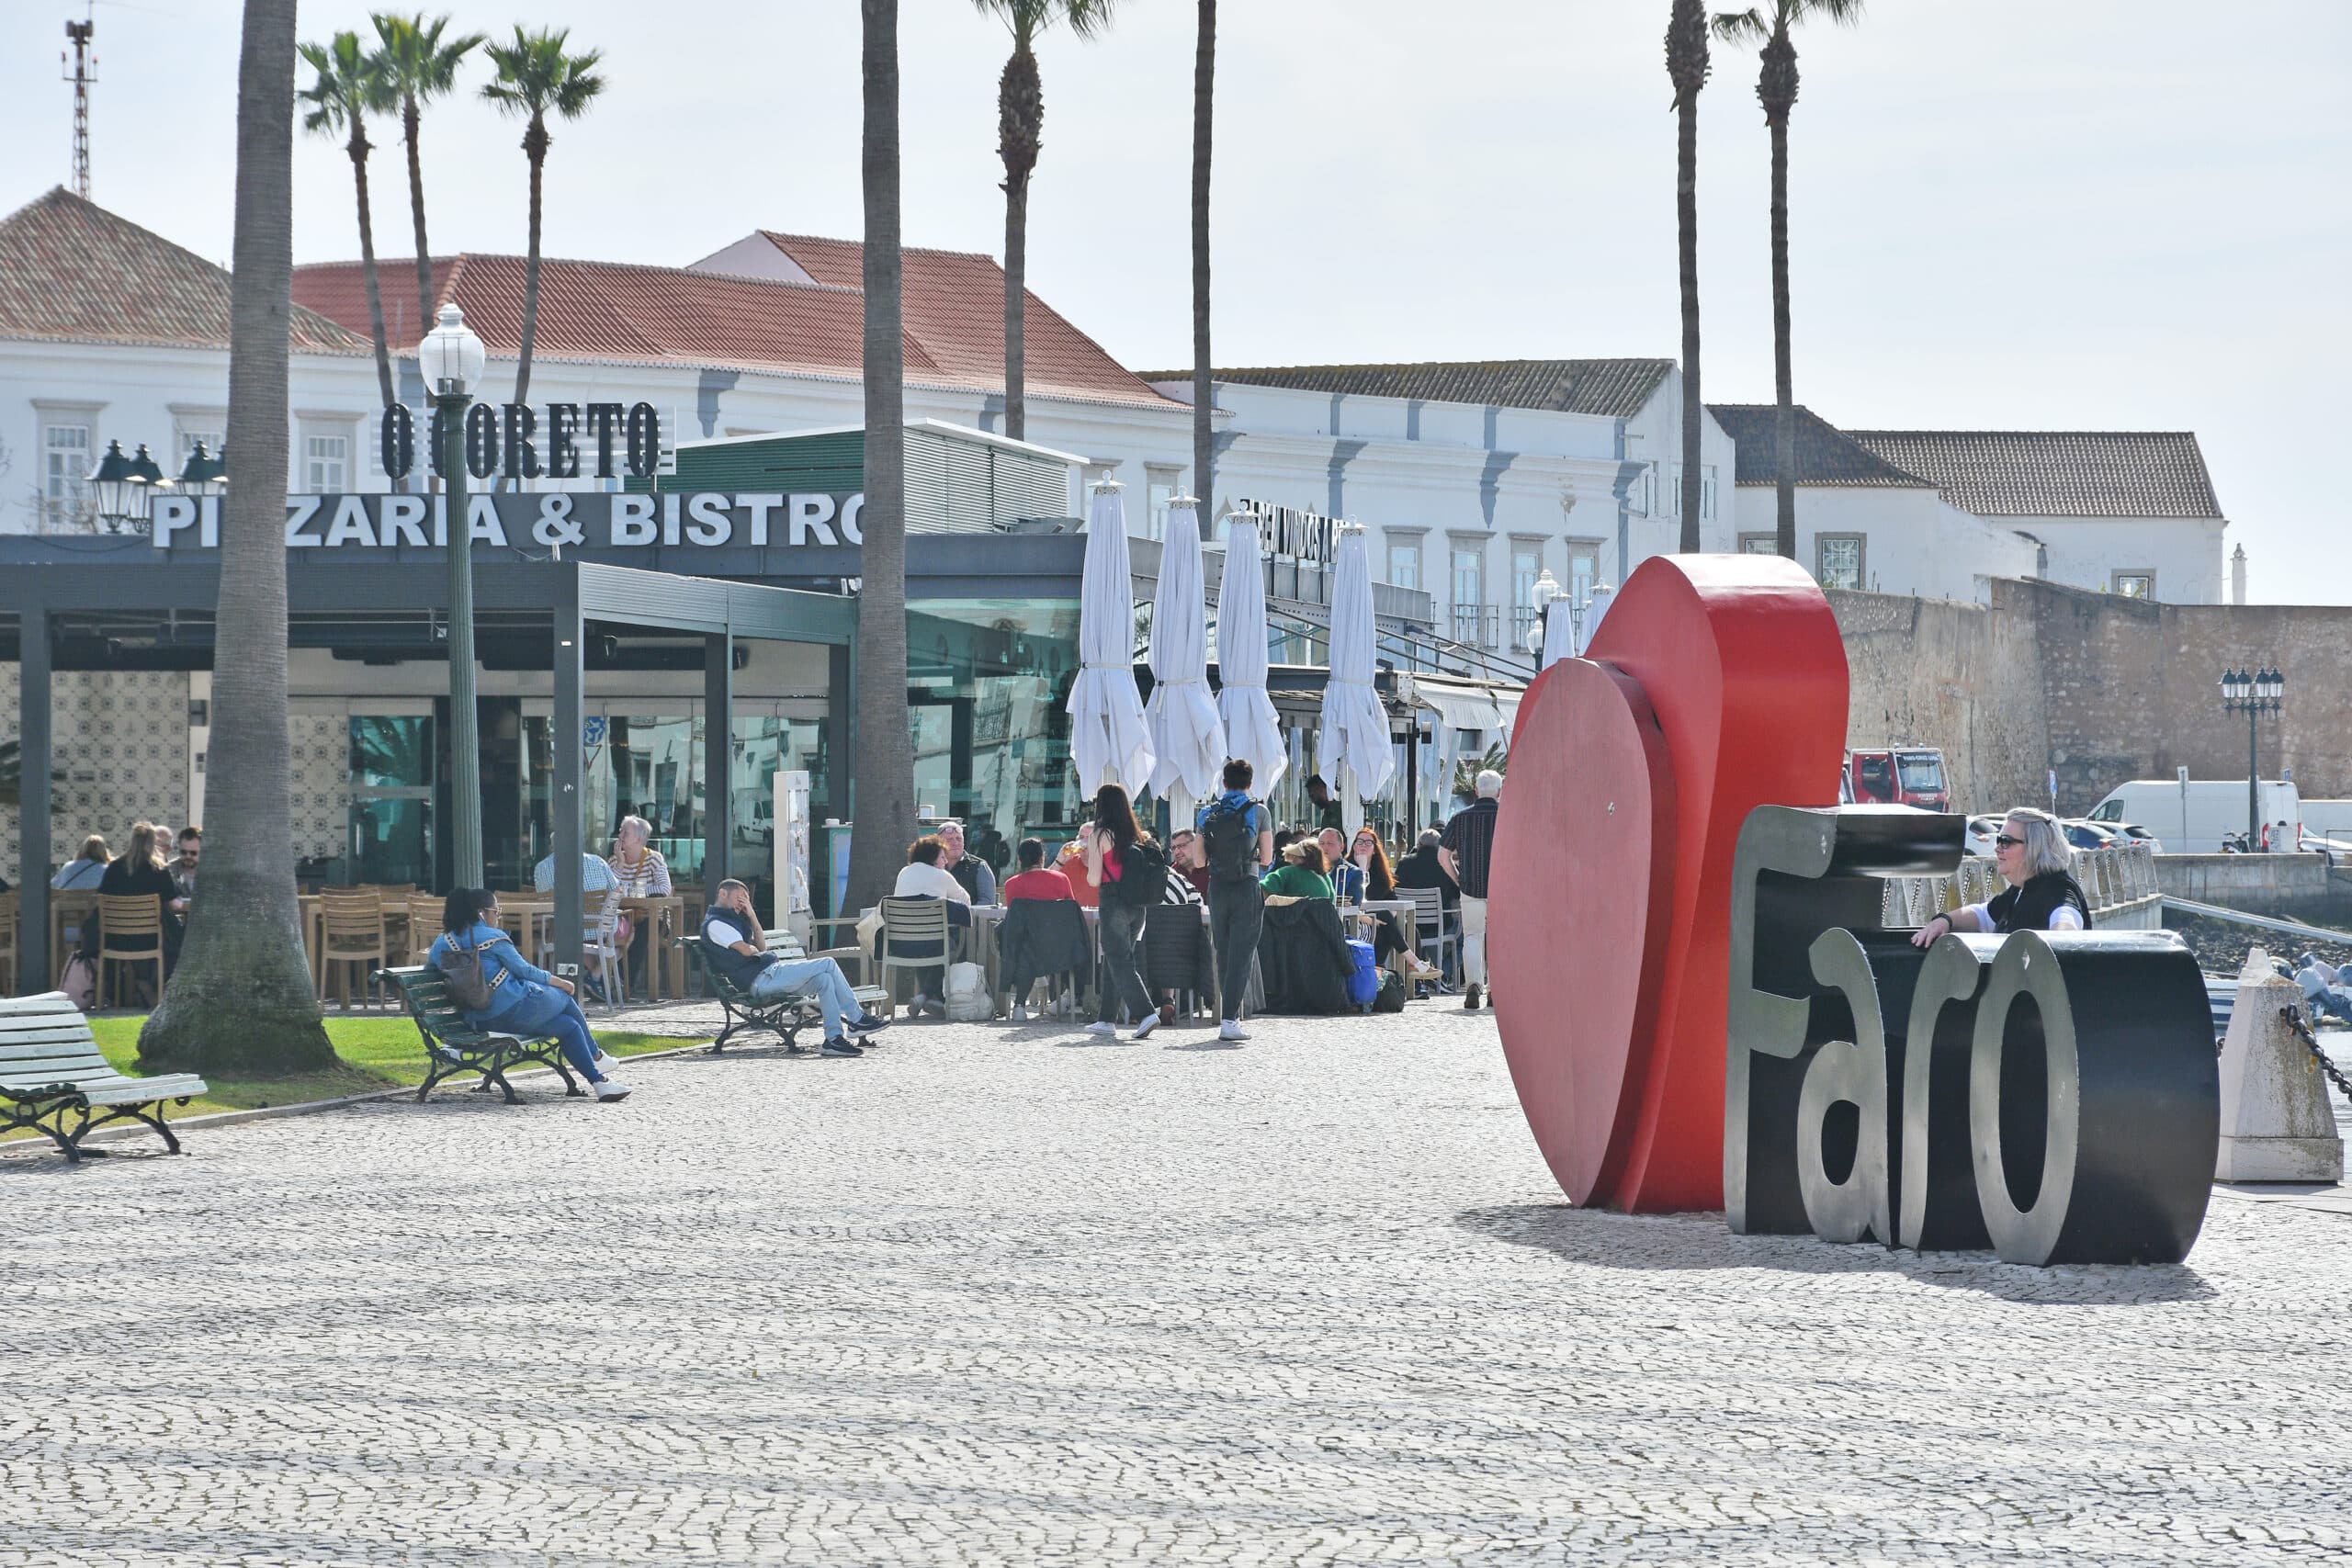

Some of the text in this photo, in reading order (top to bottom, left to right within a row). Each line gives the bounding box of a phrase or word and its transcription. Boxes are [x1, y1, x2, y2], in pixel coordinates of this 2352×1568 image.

[381, 402, 413, 479] O
[153, 495, 508, 547] PIZARIA
[532, 492, 586, 547] &
[1724, 804, 2080, 1266] Faro
